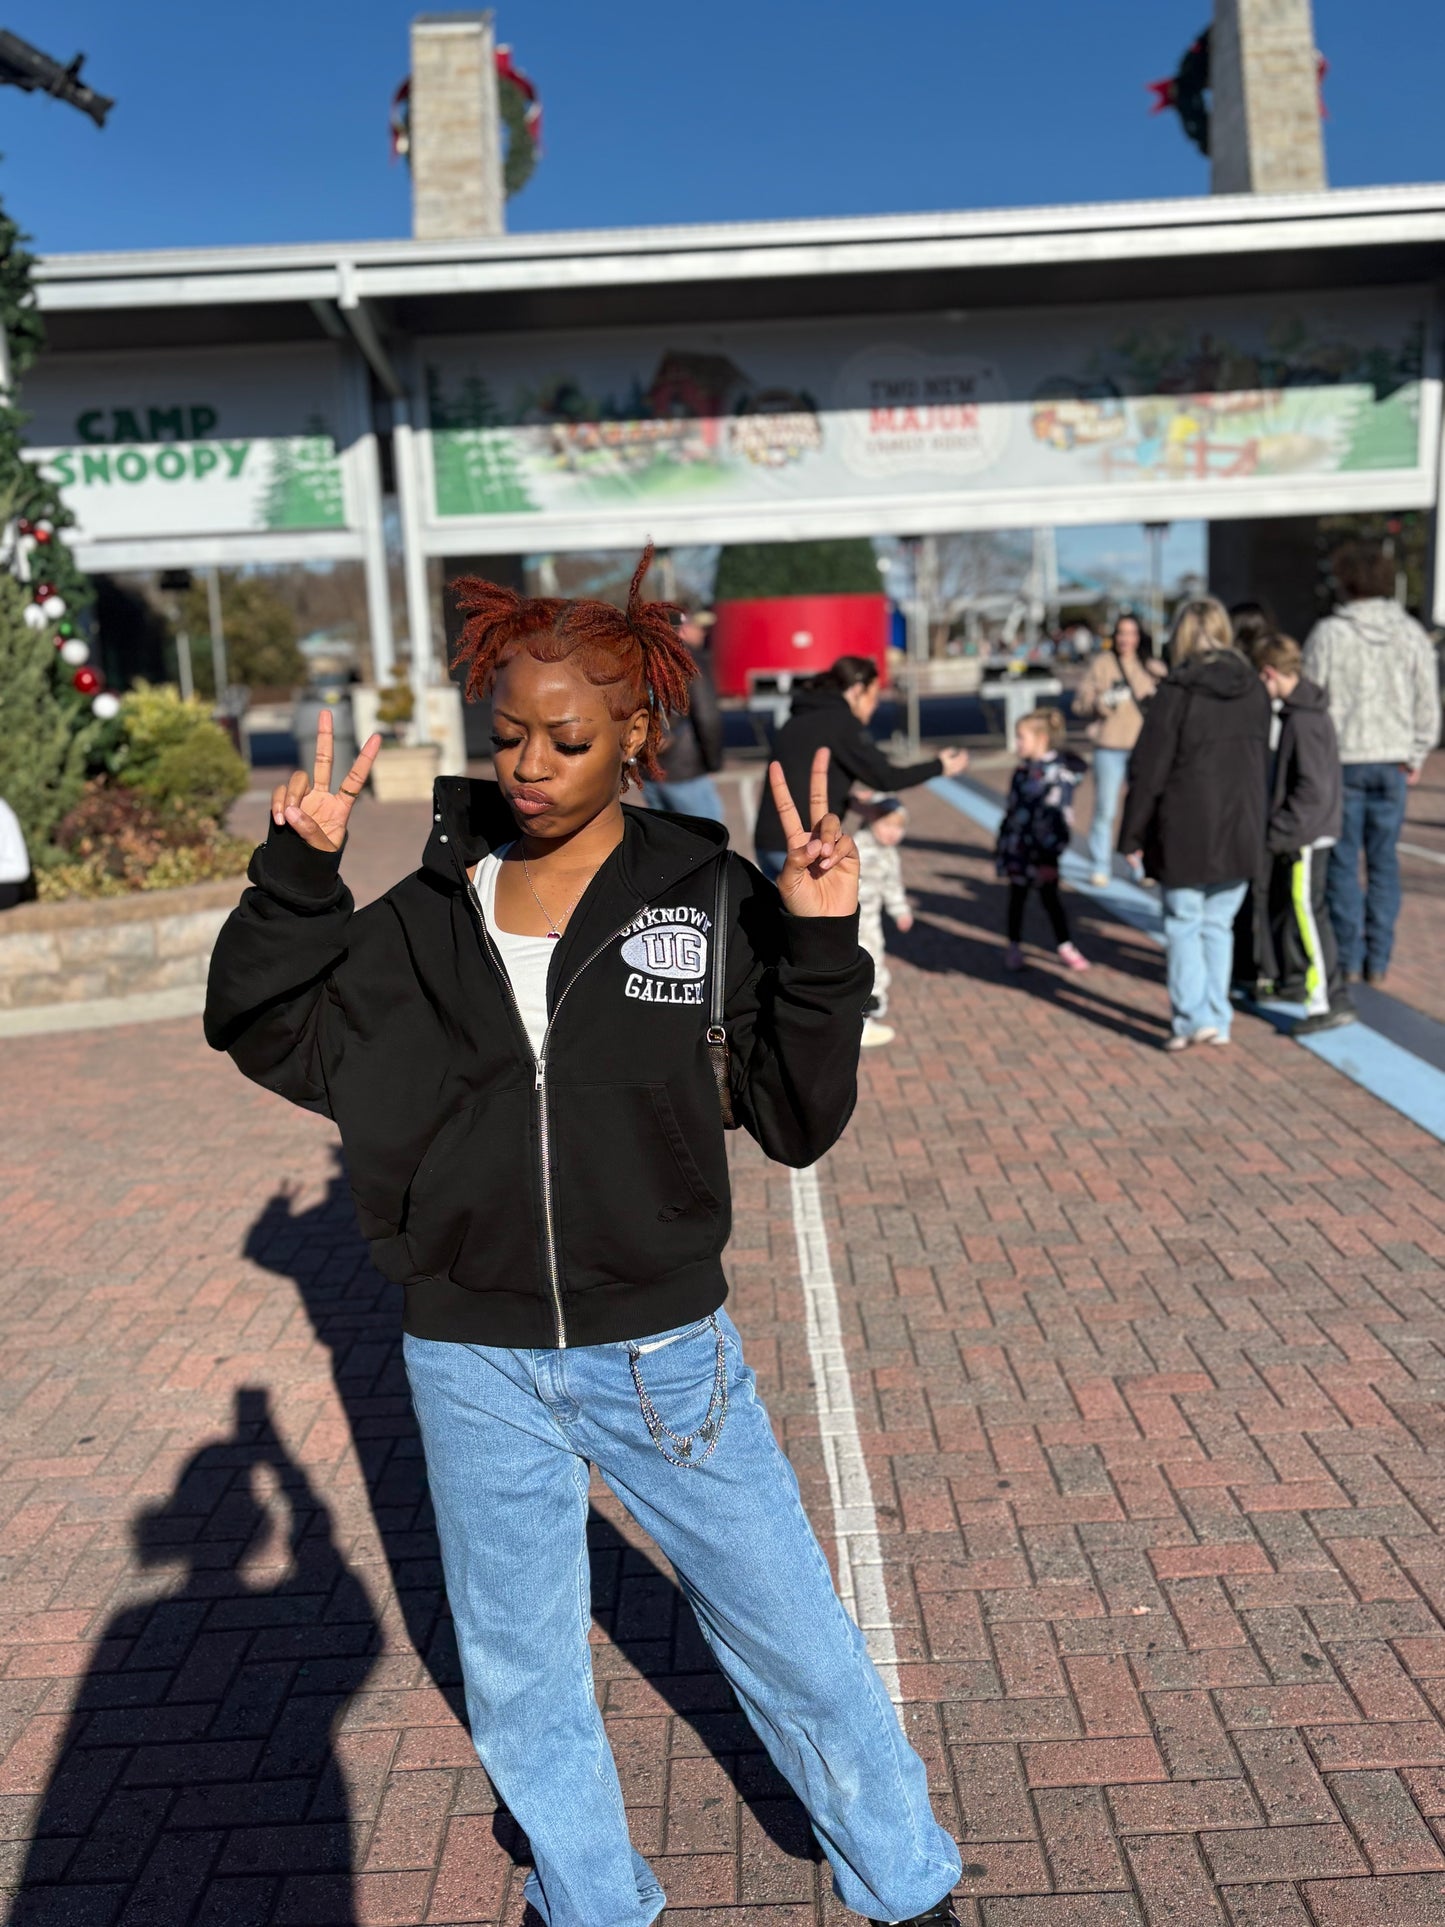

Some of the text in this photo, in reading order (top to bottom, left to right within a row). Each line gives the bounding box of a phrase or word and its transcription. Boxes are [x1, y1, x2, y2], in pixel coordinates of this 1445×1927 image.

[76, 404, 217, 443] CAMP
[869, 403, 979, 433] MAJOR
[53, 444, 250, 486] SNOOPY
[642, 932, 701, 972] UG
